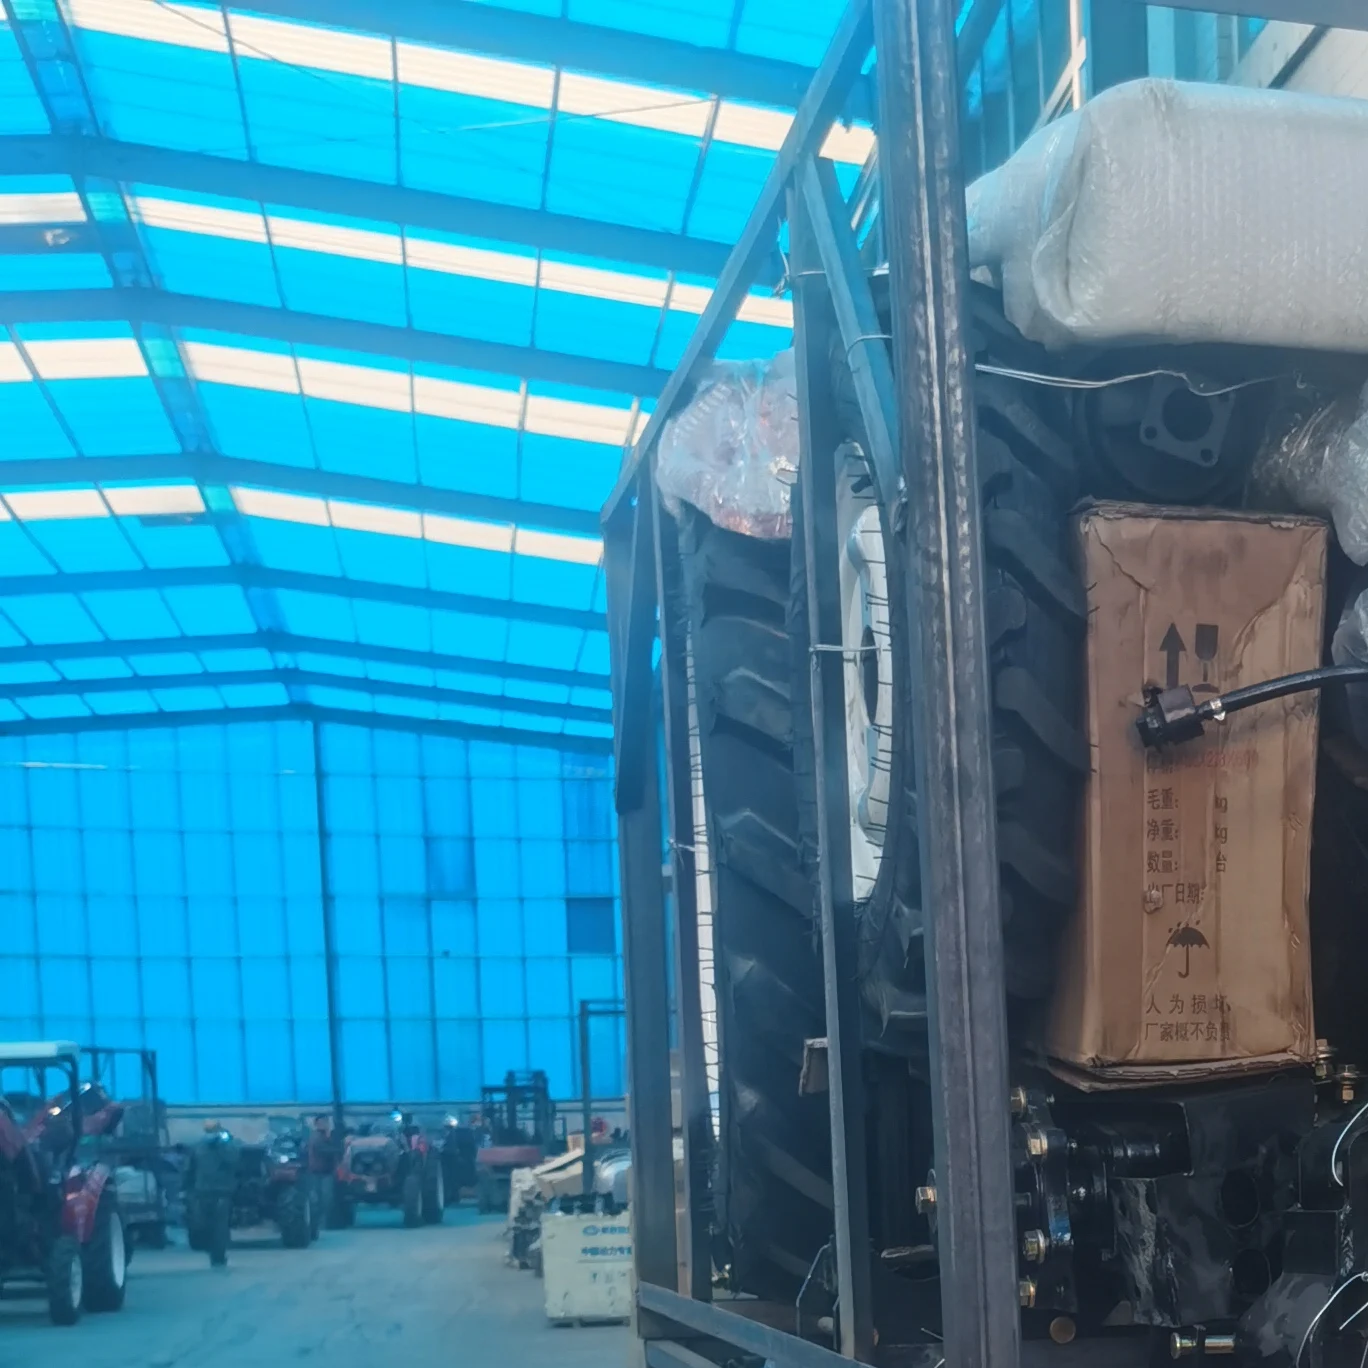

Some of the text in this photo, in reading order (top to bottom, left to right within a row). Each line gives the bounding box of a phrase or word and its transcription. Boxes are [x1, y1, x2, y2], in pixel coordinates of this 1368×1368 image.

[1147, 788, 1179, 810] 毛重:
[1147, 819, 1228, 845] 净重: kg
[1147, 850, 1227, 873] 数量: 台
